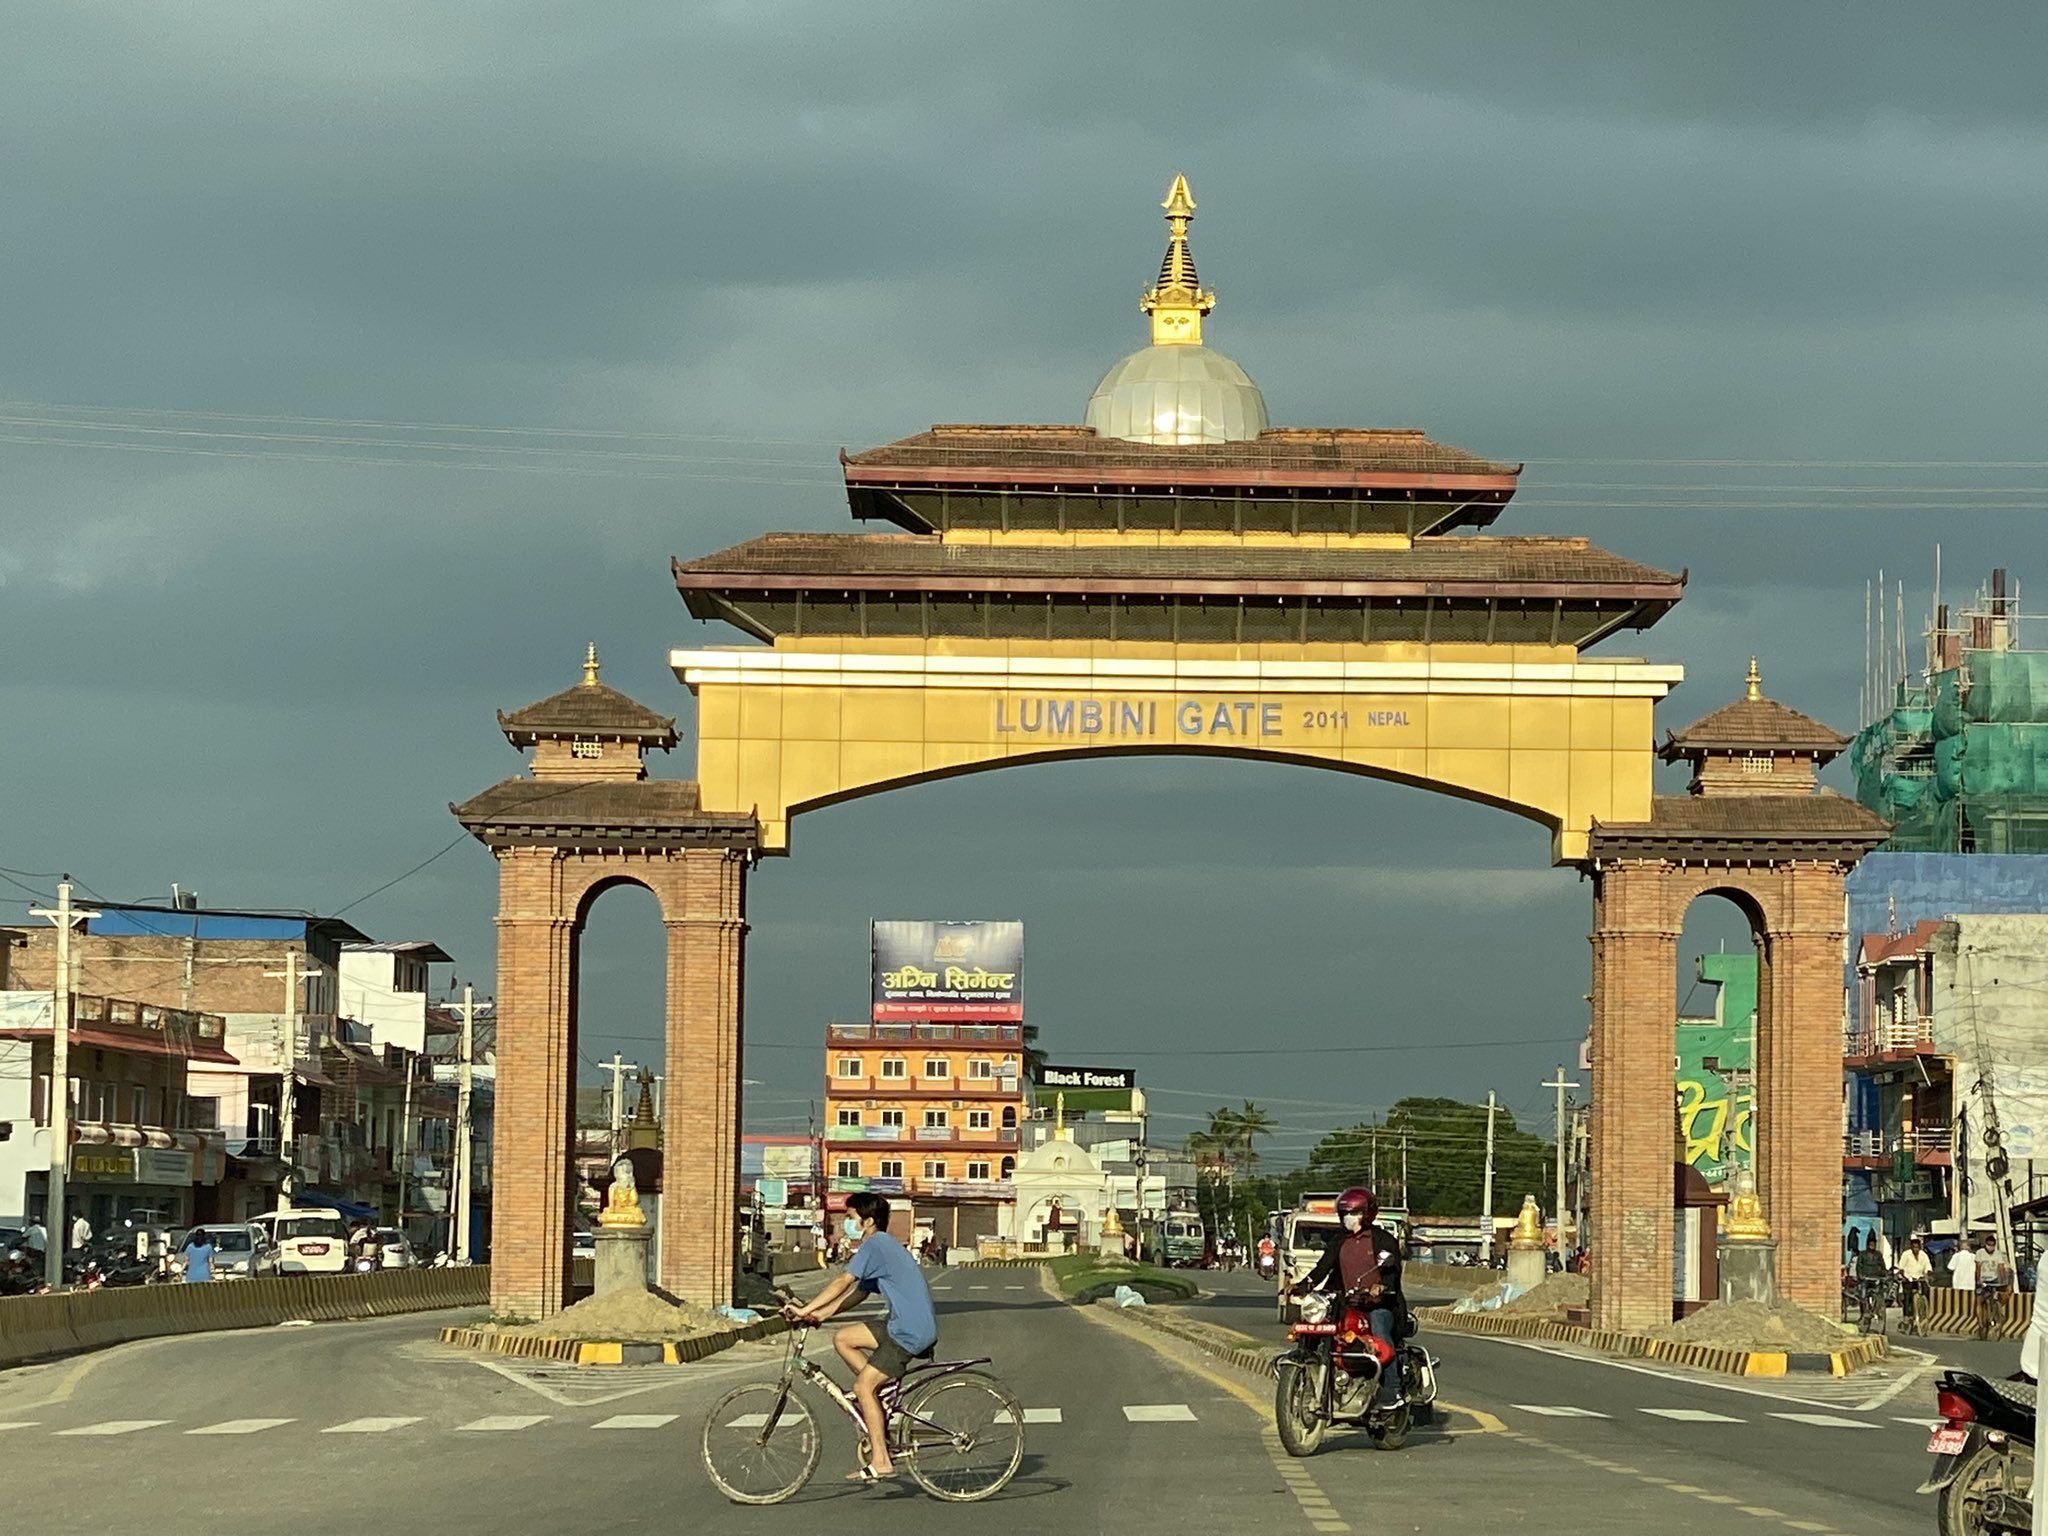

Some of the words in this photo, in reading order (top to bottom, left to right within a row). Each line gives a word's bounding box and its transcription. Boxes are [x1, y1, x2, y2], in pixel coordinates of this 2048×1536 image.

[996, 699, 1157, 735] LUMBINI
[1177, 701, 1283, 736] GATE
[1303, 711, 1348, 729] 2011
[1368, 711, 1410, 726] NEPAL
[882, 965, 938, 989] अग्नि
[945, 966, 1016, 990] सिमेन्ट
[1044, 1070, 1081, 1085] Black
[1084, 1072, 1126, 1087] Forest
